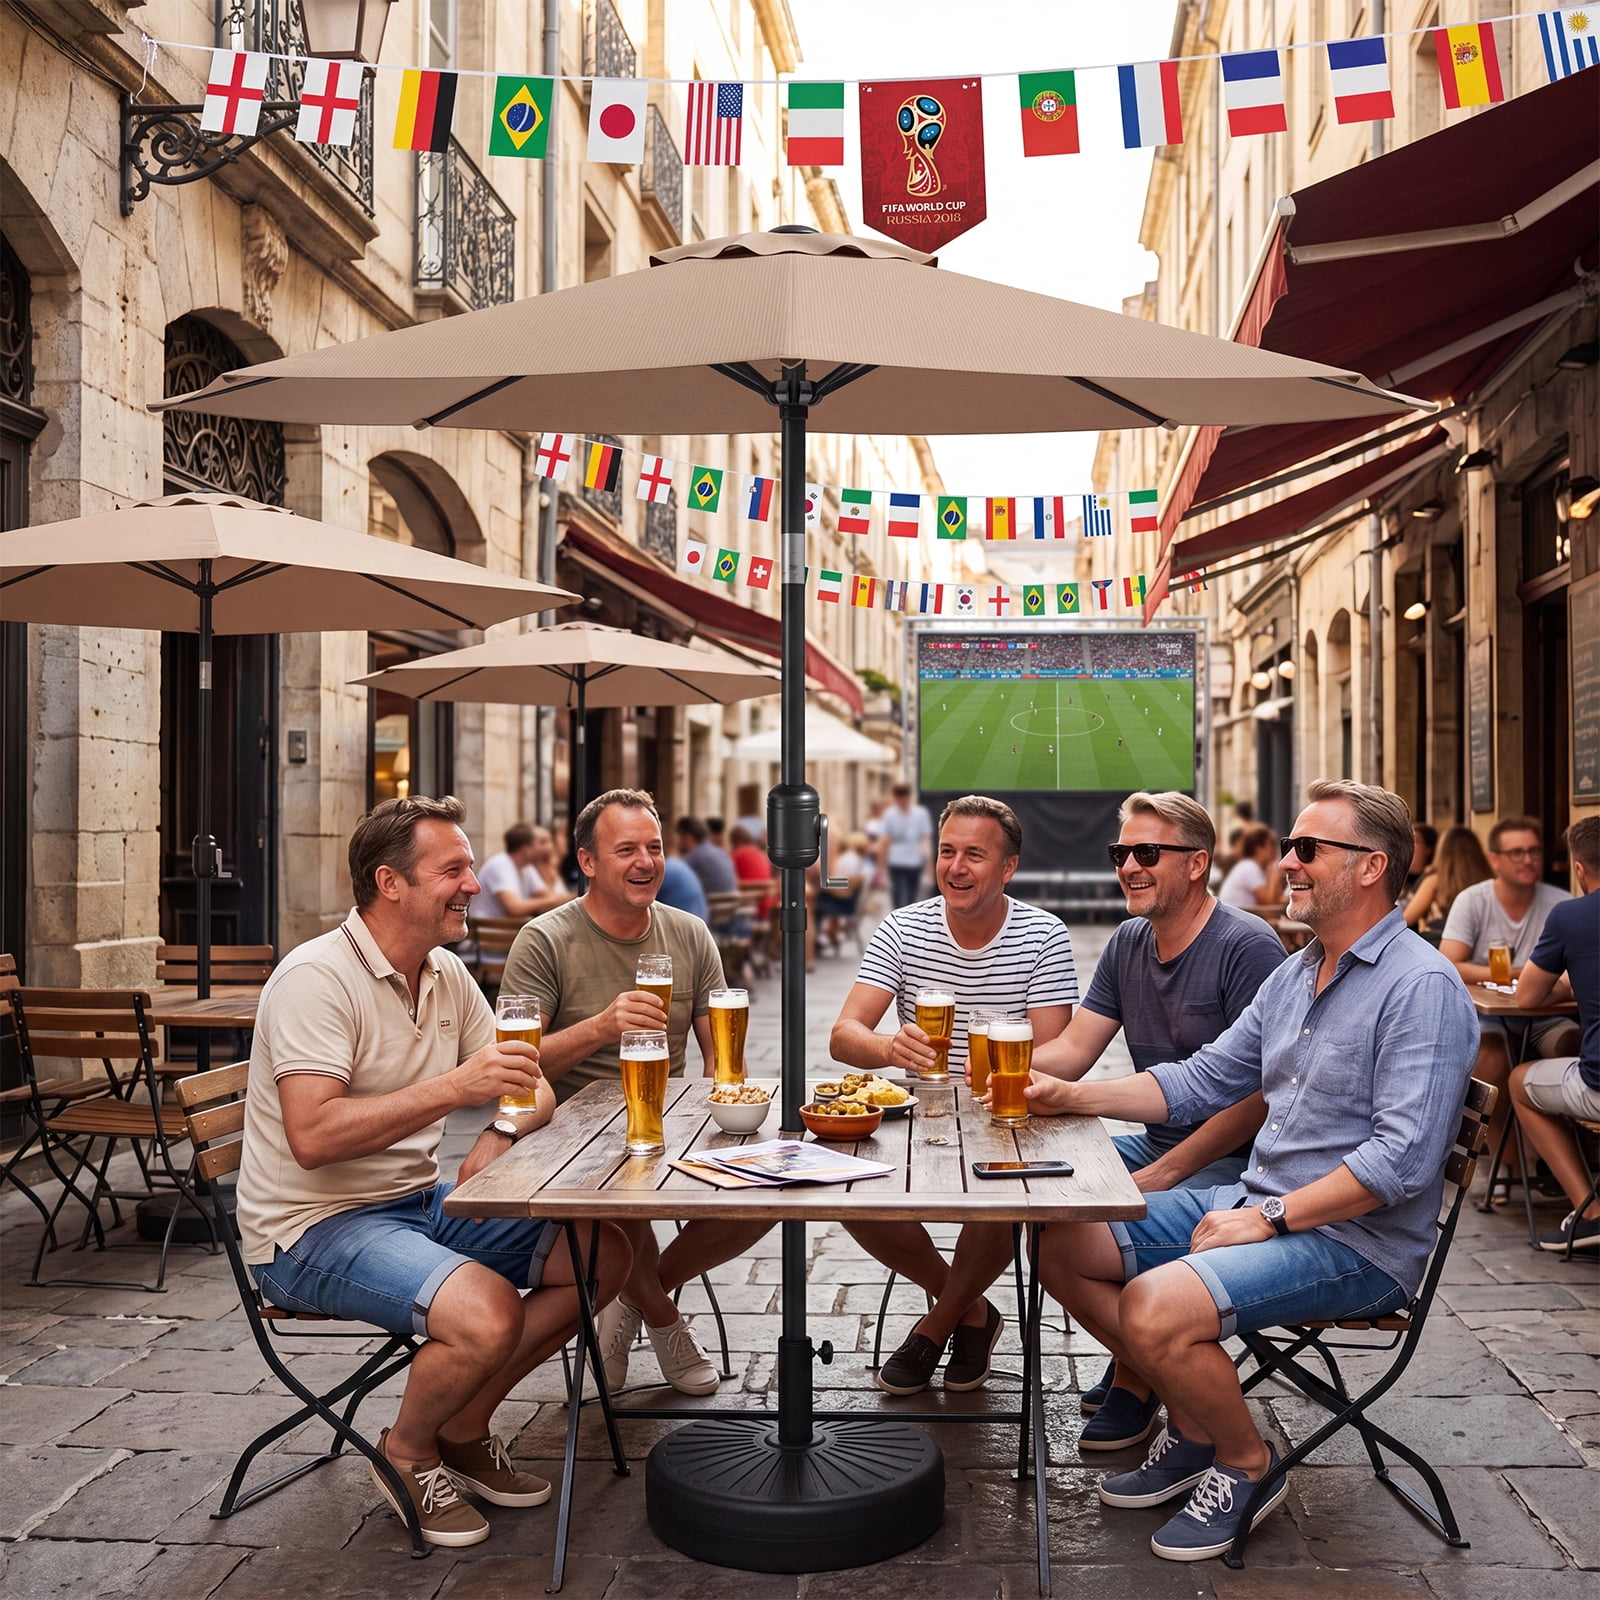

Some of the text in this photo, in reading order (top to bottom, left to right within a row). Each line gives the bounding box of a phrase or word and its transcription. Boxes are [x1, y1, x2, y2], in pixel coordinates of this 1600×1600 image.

[882, 201, 966, 213] FIFA WORLD CUP
[887, 213, 961, 224] RUSSIA 2018
